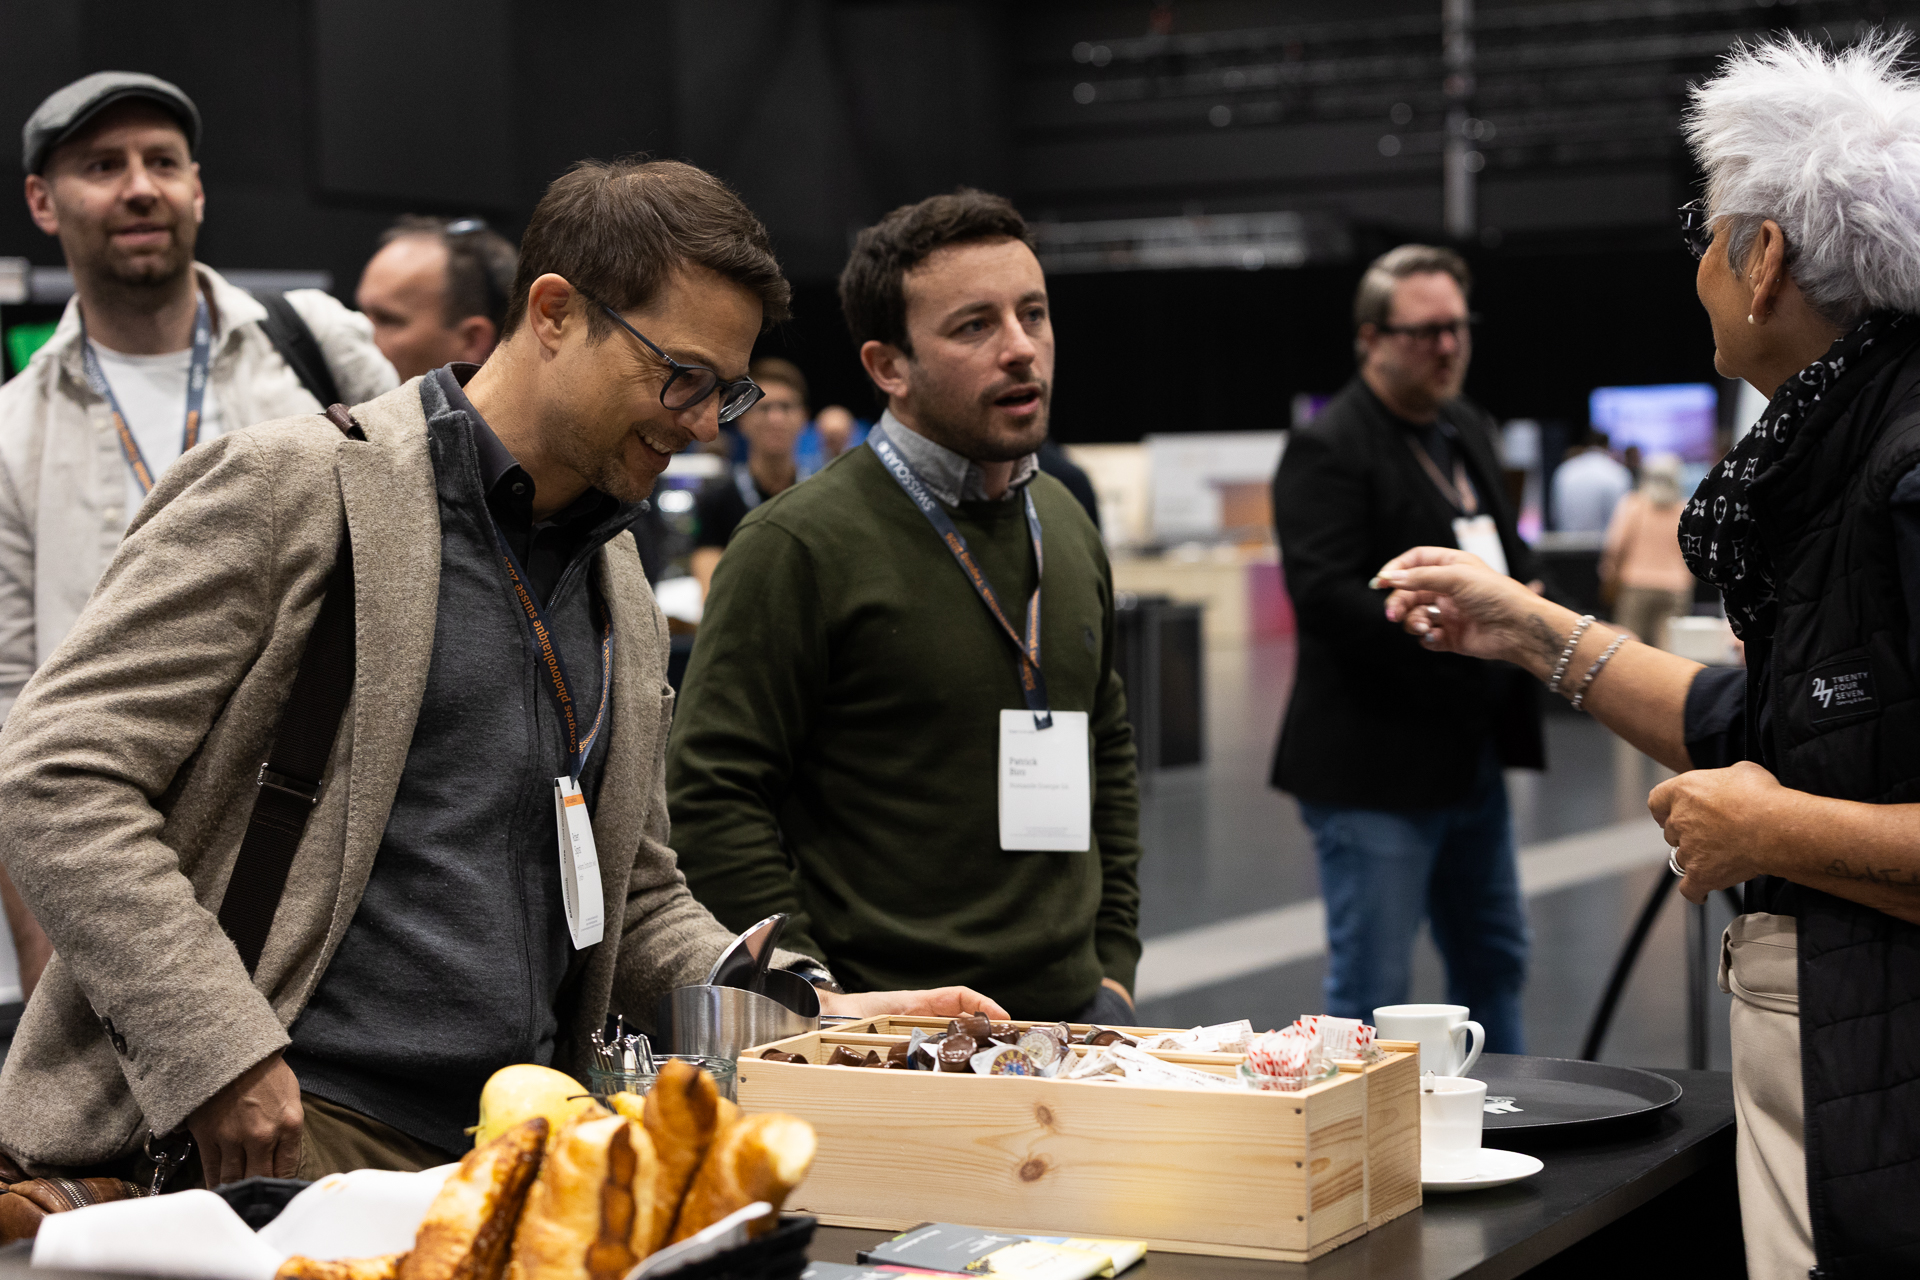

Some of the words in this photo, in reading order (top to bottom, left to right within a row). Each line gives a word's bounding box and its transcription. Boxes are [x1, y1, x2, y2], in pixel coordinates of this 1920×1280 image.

[883, 449, 936, 511] SWISSOLAR
[514, 583, 538, 619] suisse
[533, 619, 572, 703] photovoltaïque
[1832, 672, 1868, 683] TWENTY
[1834, 682, 1857, 691] FOUR
[1835, 690, 1864, 700] SEVEN
[563, 704, 577, 753] Congrès
